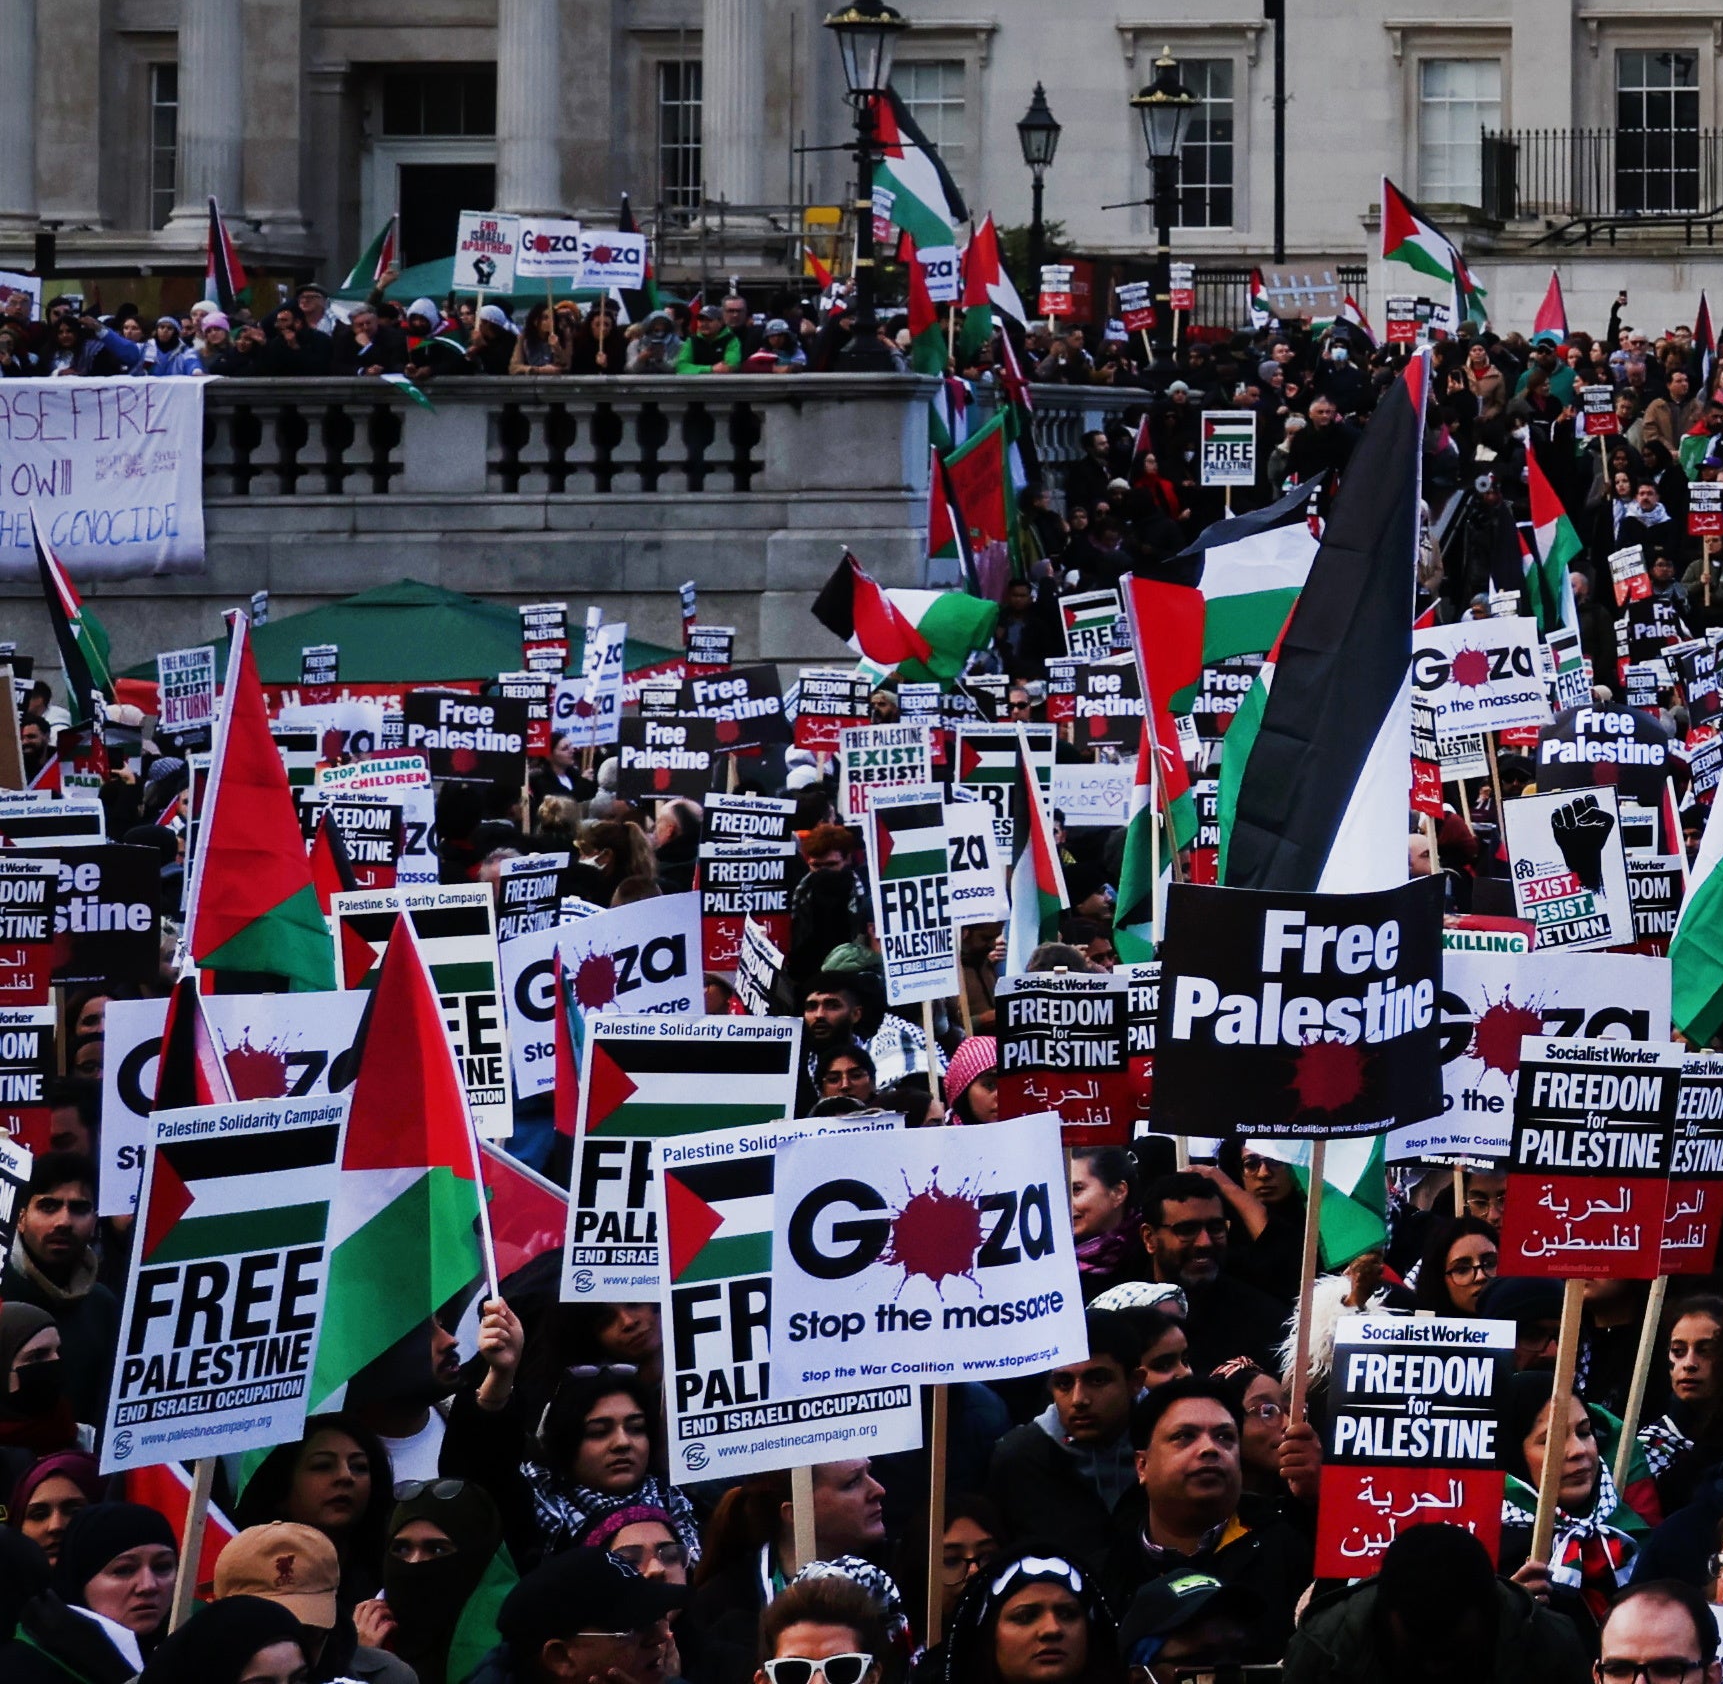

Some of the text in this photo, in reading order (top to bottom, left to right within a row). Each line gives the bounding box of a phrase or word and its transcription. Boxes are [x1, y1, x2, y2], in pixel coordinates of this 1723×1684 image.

[1203, 461, 1252, 471] PALESTINE
[1204, 444, 1253, 461] FREE
[1412, 645, 1535, 691] Gza
[439, 699, 494, 724] Free
[1574, 708, 1634, 734] Free
[408, 725, 522, 753] Palestine
[645, 722, 686, 744] Free
[621, 746, 709, 770] Palestine
[847, 747, 924, 766] EXIST!
[1542, 739, 1664, 765] Palestine
[709, 862, 784, 881] FREEDOM
[704, 893, 787, 911] PALESTINE
[880, 877, 949, 935] FREE
[885, 929, 953, 960] PALESTINE
[1262, 909, 1399, 976] Free
[1171, 975, 1434, 1046] Palestine
[1532, 1071, 1663, 1112] FREEDOM
[157, 1104, 343, 1138] Palestine Solidarity Campaign
[1519, 1129, 1663, 1169] PALESTINE
[1538, 1184, 1631, 1222] الحرية
[788, 1178, 1055, 1280] Gza
[1521, 1223, 1640, 1257] لفلسطين
[126, 1246, 323, 1356] FREE
[789, 1290, 1063, 1343] Stop the massacre
[119, 1333, 313, 1399] PALESTINE
[802, 1369, 831, 1384] Stop
[835, 1366, 856, 1378] the
[860, 1363, 887, 1376] War
[891, 1359, 954, 1374] Coalition
[1346, 1353, 1494, 1397] FREEDOM
[117, 1380, 303, 1425] END ISRAELI OCCUPATION
[1407, 1396, 1431, 1416] for
[717, 1423, 878, 1459] www.palestinecampaign.org
[1334, 1416, 1497, 1460] PALESTINE
